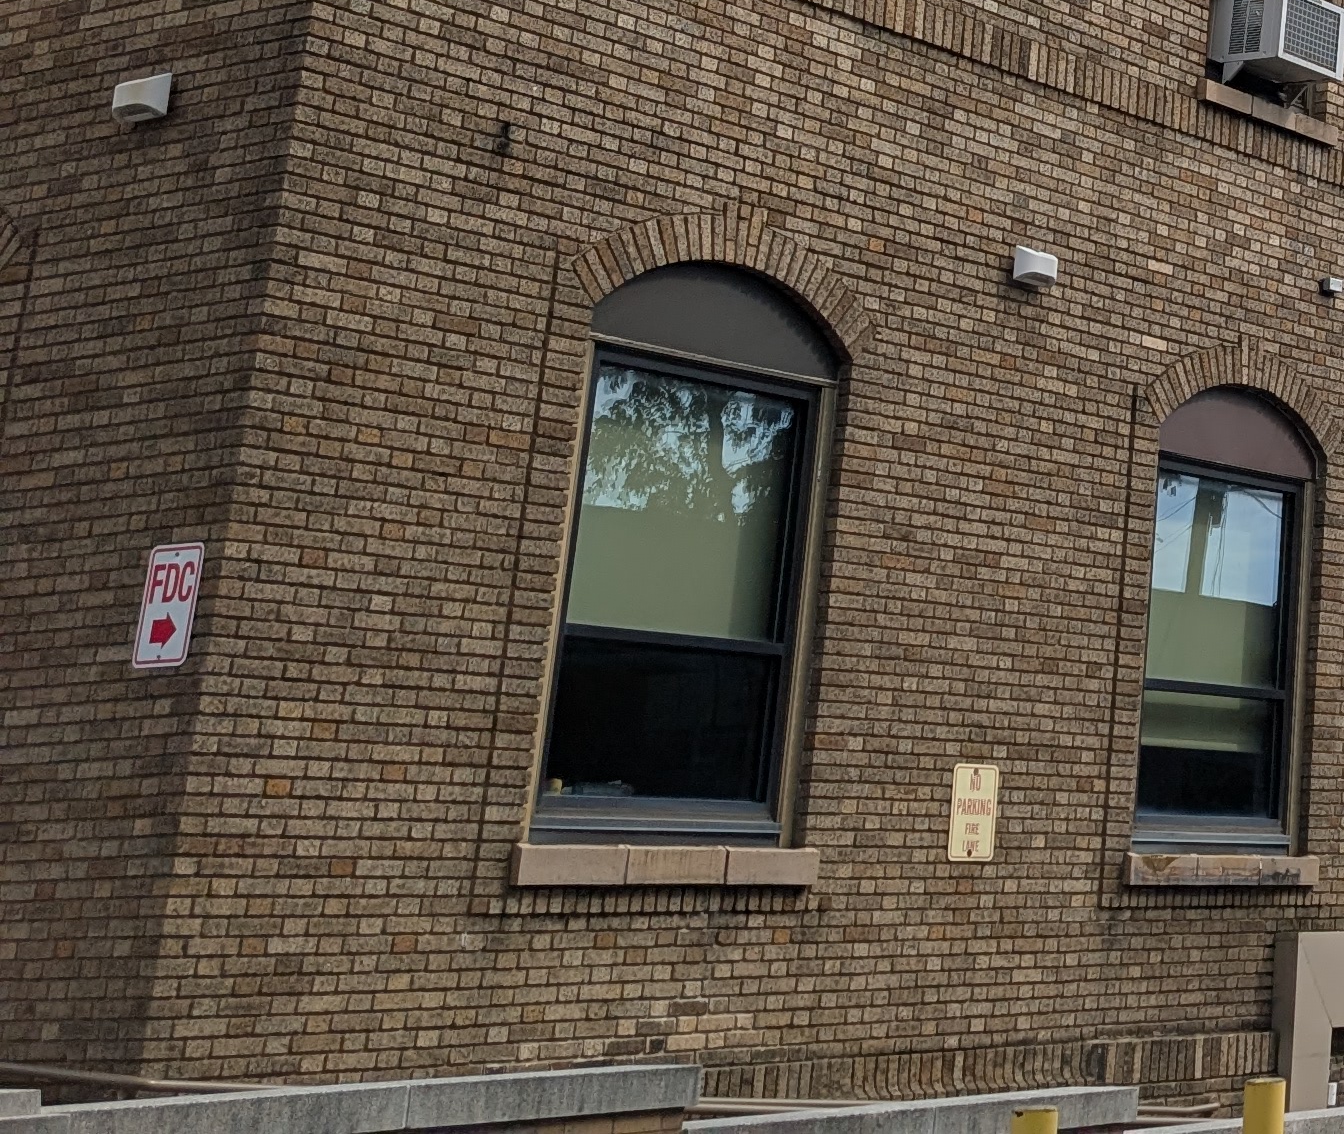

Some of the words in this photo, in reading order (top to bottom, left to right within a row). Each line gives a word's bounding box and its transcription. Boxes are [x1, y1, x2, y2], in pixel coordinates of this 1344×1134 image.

[149, 561, 195, 604] FDC
[970, 774, 981, 791] NO
[956, 798, 992, 816] PARKING
[965, 823, 980, 835] FIRE
[962, 840, 980, 852] LANE
